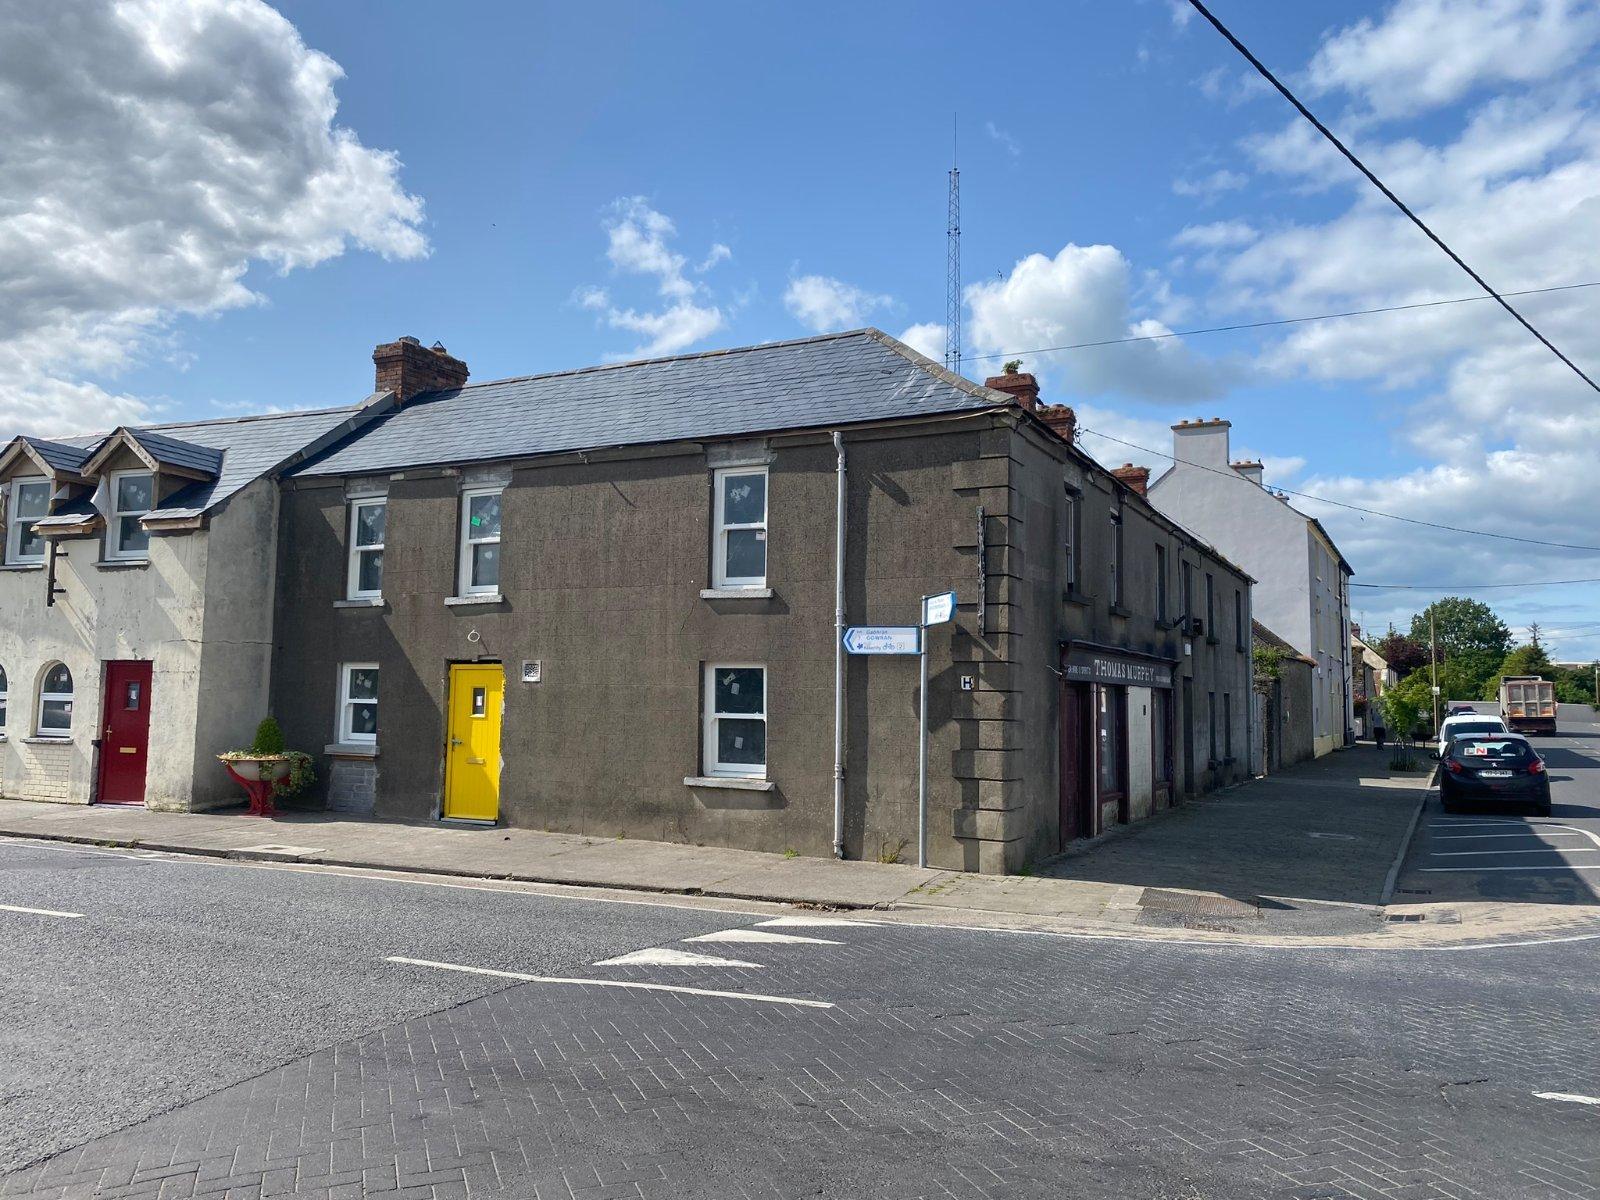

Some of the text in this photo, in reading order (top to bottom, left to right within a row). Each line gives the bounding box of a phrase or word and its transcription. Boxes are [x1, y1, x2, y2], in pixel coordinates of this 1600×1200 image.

[1094, 659, 1126, 678] THOMAS
[1126, 665, 1155, 682] MURPHY
[963, 677, 972, 688] H
